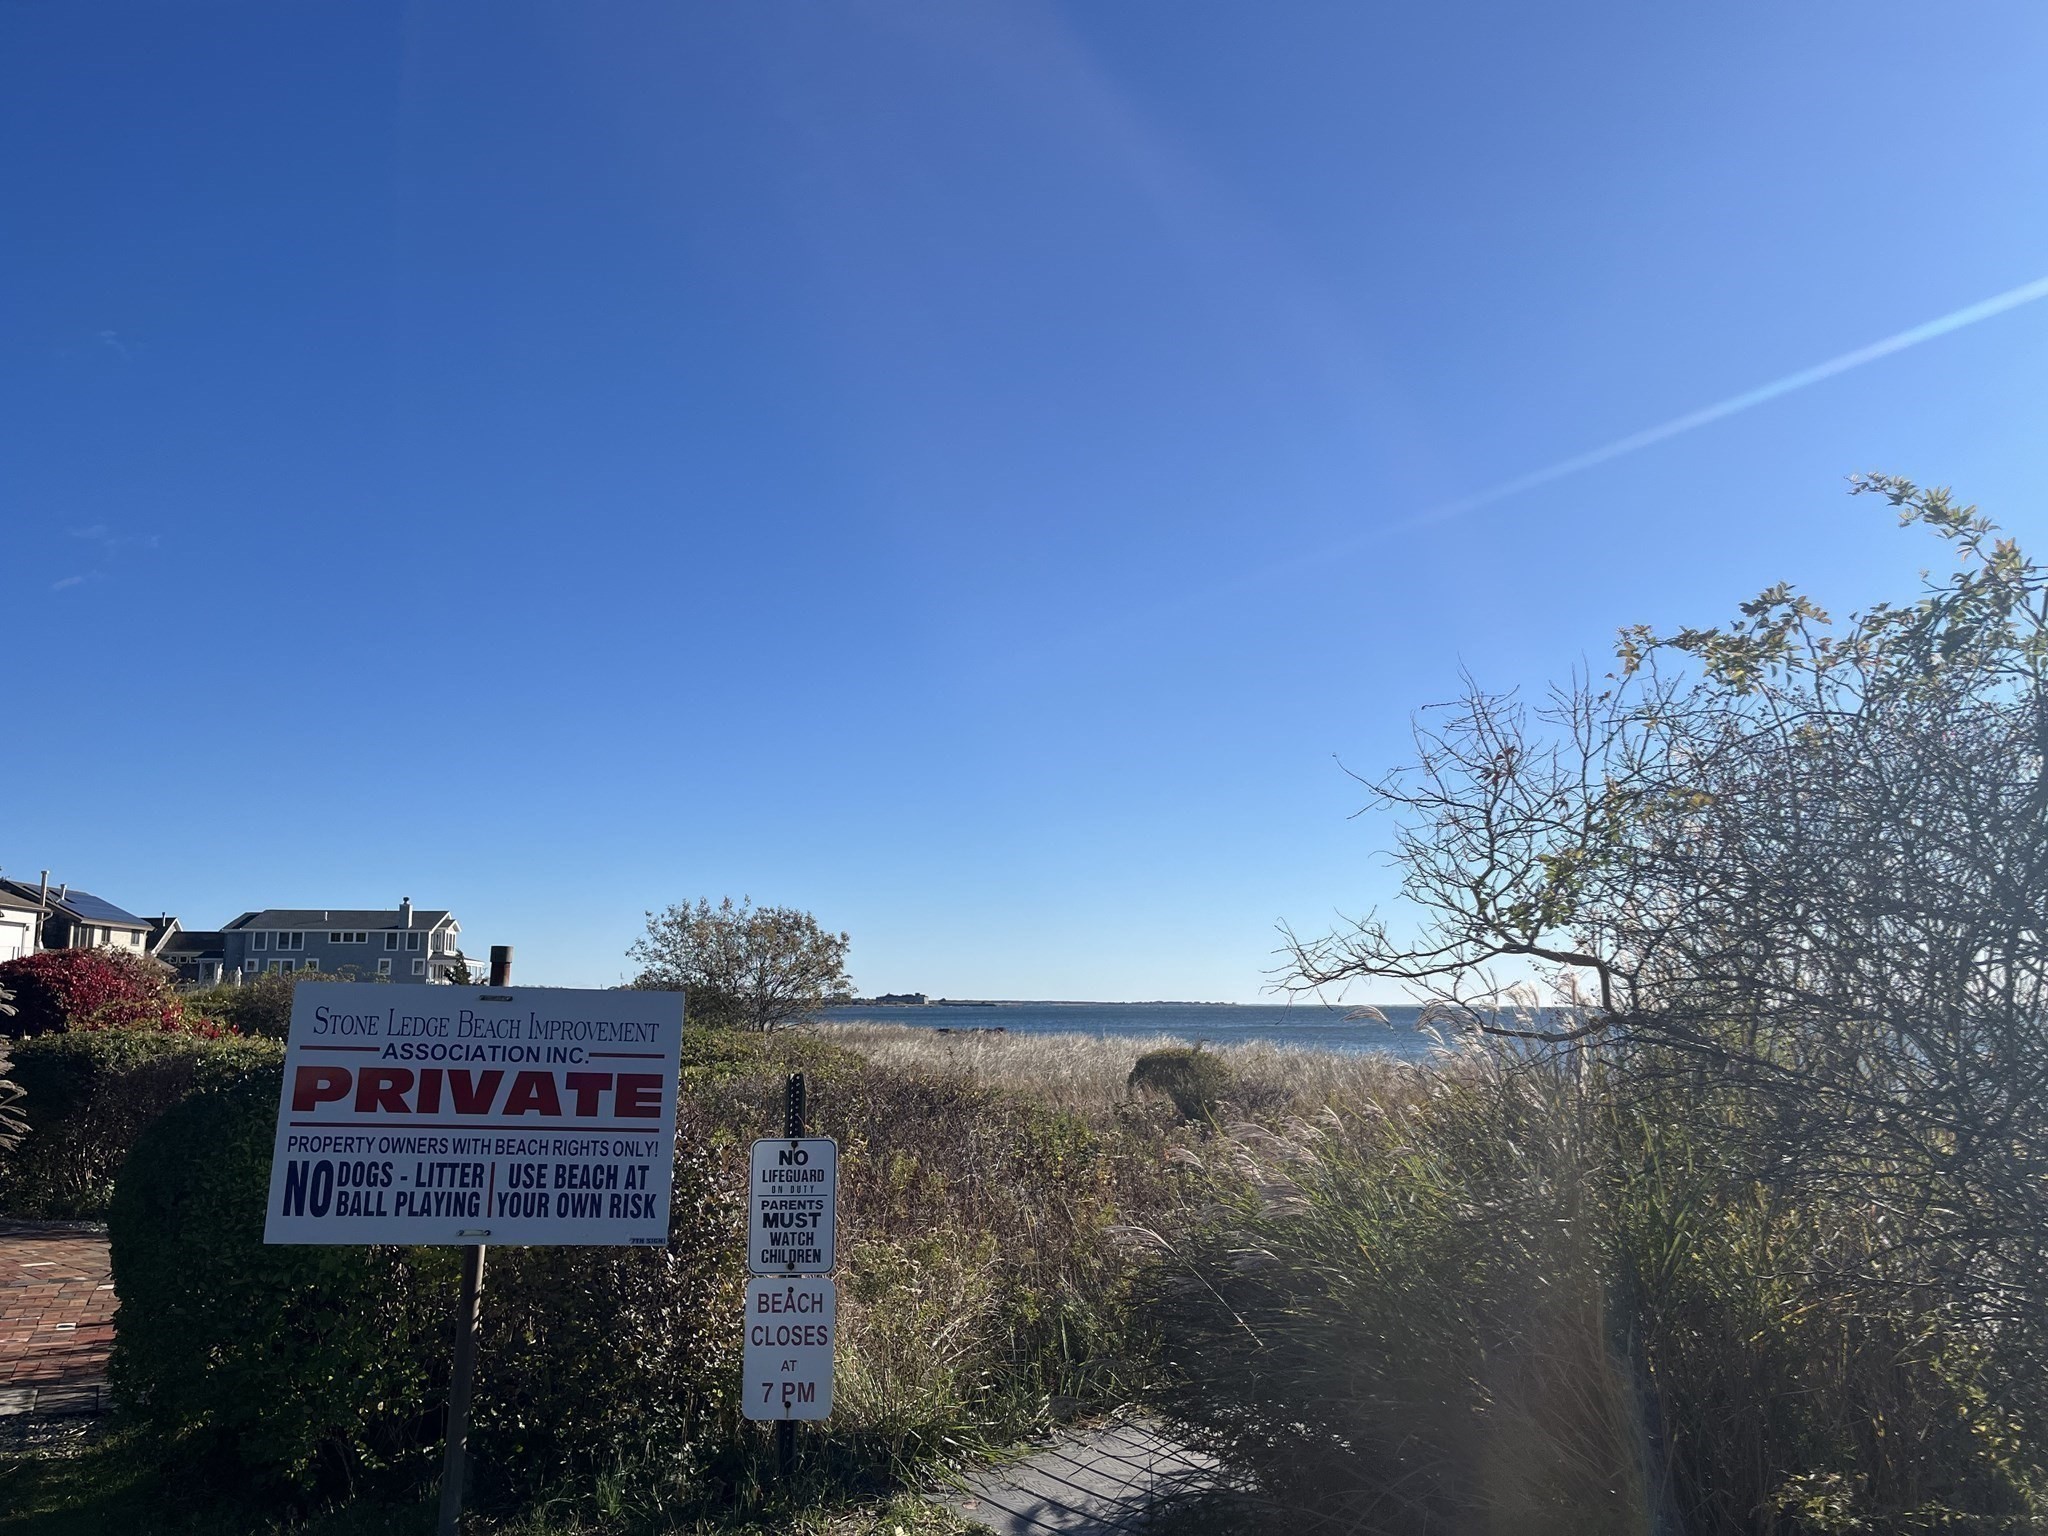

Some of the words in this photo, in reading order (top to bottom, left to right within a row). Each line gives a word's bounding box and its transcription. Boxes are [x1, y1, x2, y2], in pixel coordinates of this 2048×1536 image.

[382, 1042, 540, 1063] ASSOCIATION
[546, 1046, 589, 1064] INC.
[292, 1065, 663, 1118] PRIVATE
[288, 1135, 375, 1153] PROPERTY
[378, 1137, 448, 1155] OWNERS
[452, 1138, 492, 1155] WITH
[495, 1139, 548, 1156] BEACH
[552, 1140, 609, 1157] RIGHTS
[612, 1141, 658, 1157] ONLY!
[778, 1150, 809, 1166] NO
[337, 1161, 393, 1188] DOGS
[415, 1162, 485, 1188] LITTER
[508, 1163, 548, 1189] USE
[554, 1164, 618, 1190] BEACH
[624, 1166, 649, 1190] AT
[762, 1169, 825, 1183] LIFEGUARD
[282, 1159, 334, 1218] NO
[771, 1185, 783, 1194] ON
[790, 1185, 815, 1194] DUTY
[336, 1190, 387, 1217] BALL
[394, 1191, 481, 1218] PLAYING
[497, 1192, 550, 1218] YOUR
[556, 1192, 603, 1219] OWN
[608, 1193, 657, 1219] RISK
[761, 1200, 824, 1211] PARENTS
[762, 1212, 821, 1229] MUST
[770, 1231, 814, 1247] WATCH
[761, 1248, 822, 1264] CHILDREN
[757, 1292, 823, 1314] BEACH
[751, 1325, 828, 1347] CLOSES
[780, 1360, 797, 1372] AT
[762, 1382, 774, 1403] 7
[781, 1382, 815, 1403] PM
